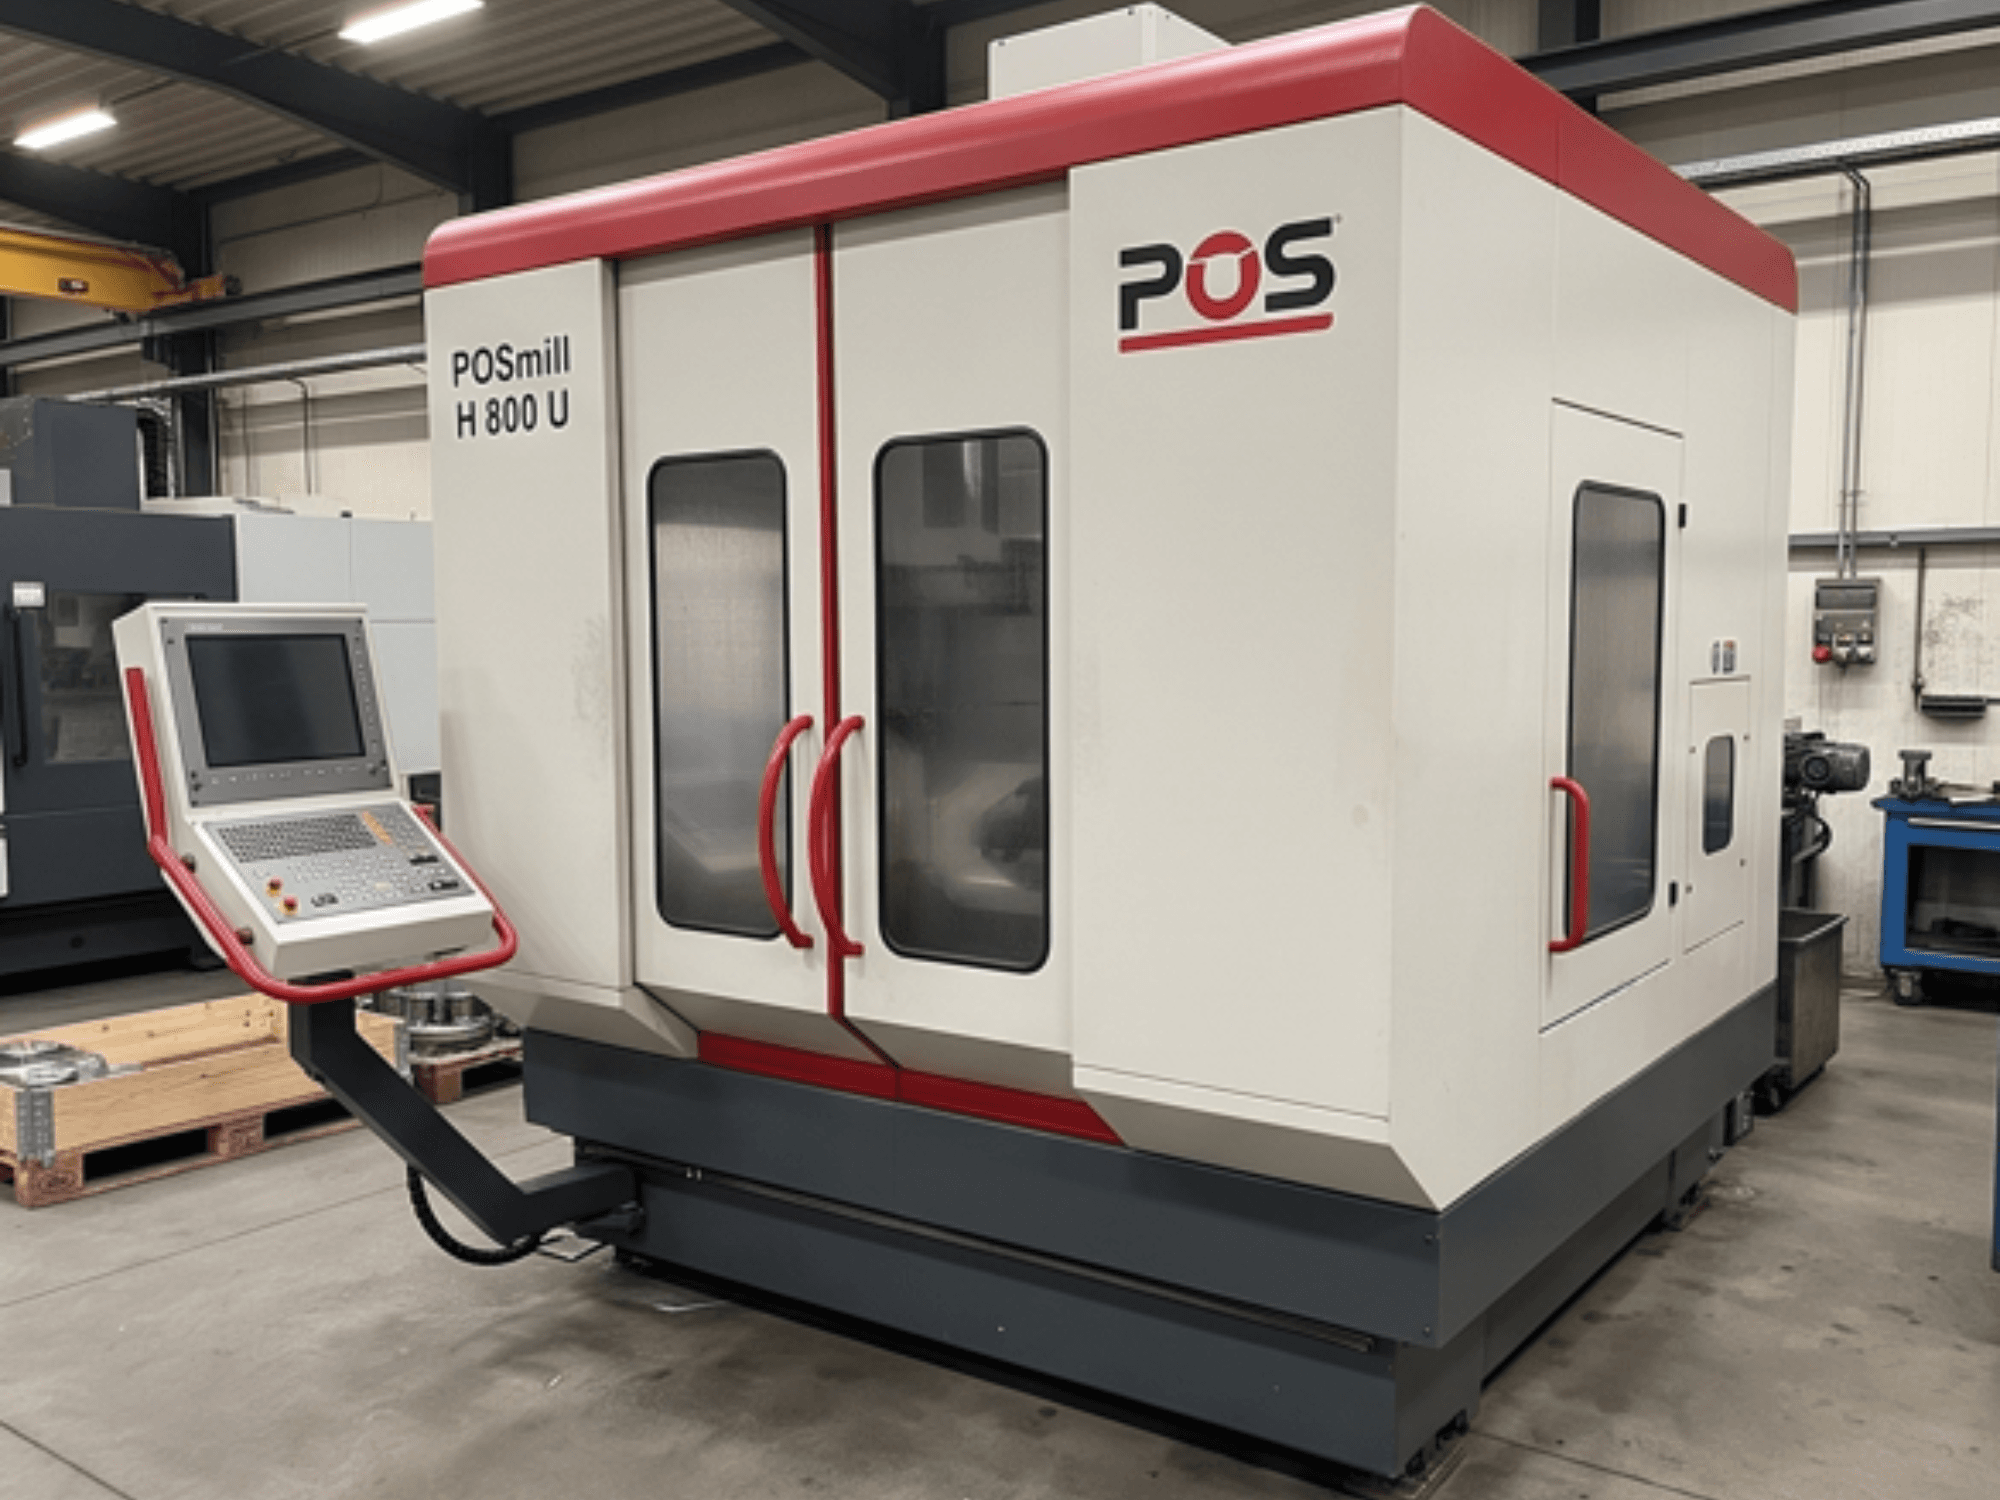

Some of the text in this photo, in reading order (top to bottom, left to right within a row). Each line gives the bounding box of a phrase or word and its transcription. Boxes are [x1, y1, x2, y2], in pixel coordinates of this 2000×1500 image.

[1119, 217, 1334, 330] POS
[453, 334, 569, 387] POSmill
[457, 388, 569, 438] H 800 U
